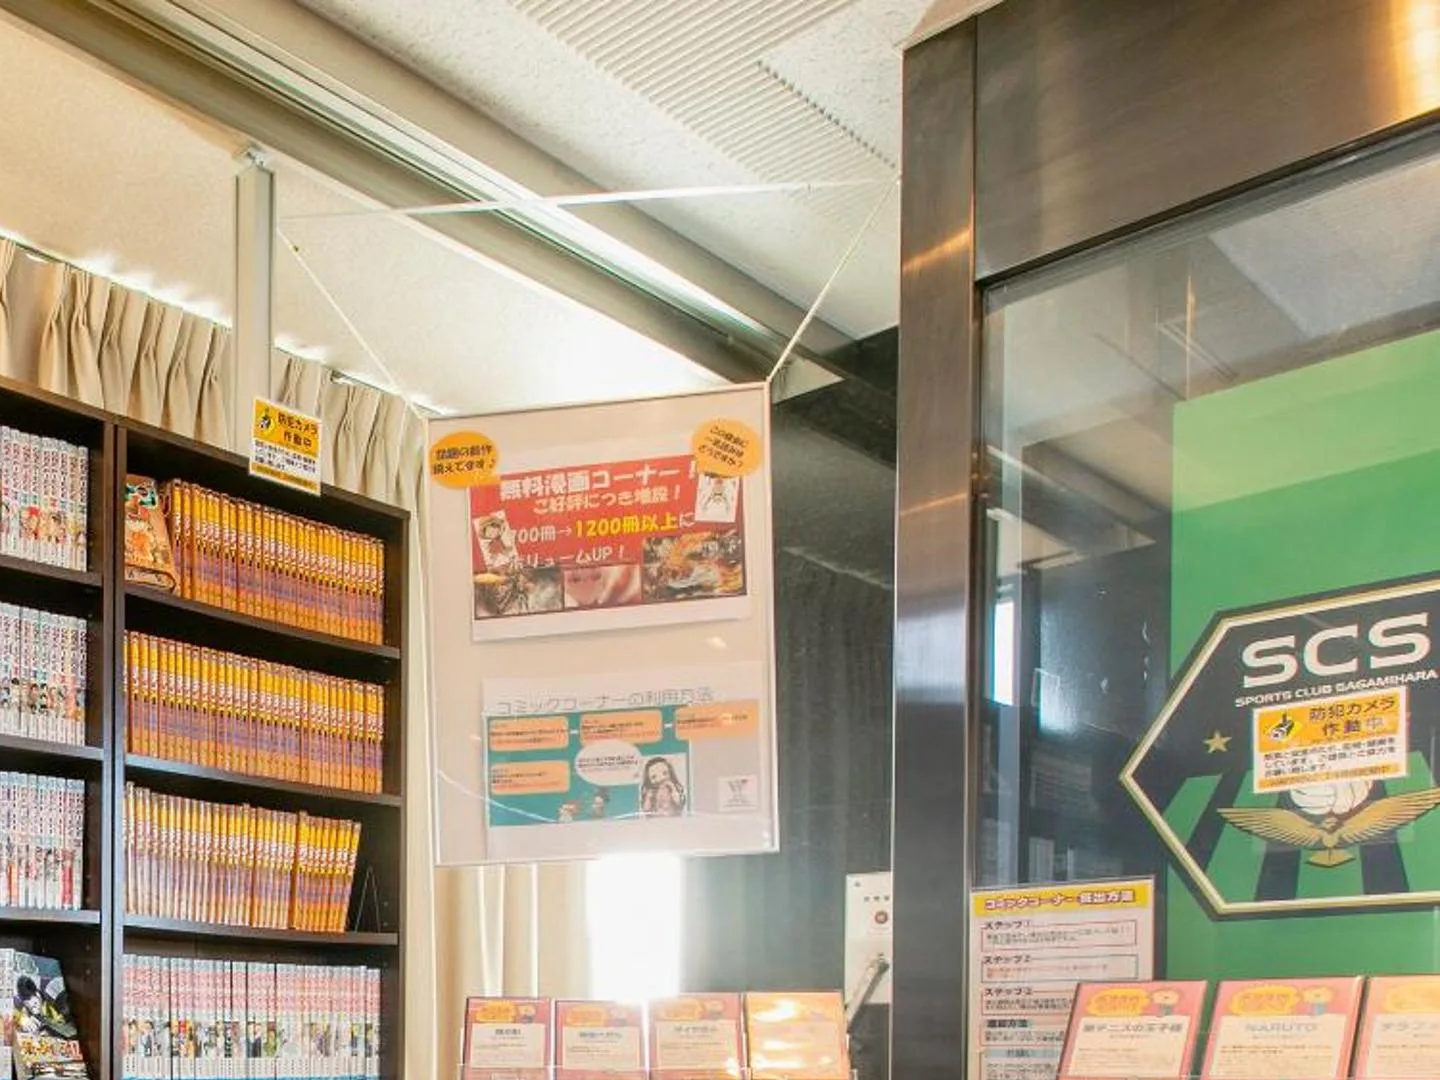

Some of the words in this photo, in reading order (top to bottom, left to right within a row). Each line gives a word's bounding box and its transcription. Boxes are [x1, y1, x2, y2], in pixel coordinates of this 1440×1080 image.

[1242, 612, 1431, 689] SCS
[1235, 691, 1292, 708] SPORTS
[1295, 683, 1333, 699] CLUB
[1335, 668, 1440, 693] SAGAMIHARA
[1309, 696, 1395, 721] 防犯カメラ
[1322, 716, 1384, 737] 作動中
